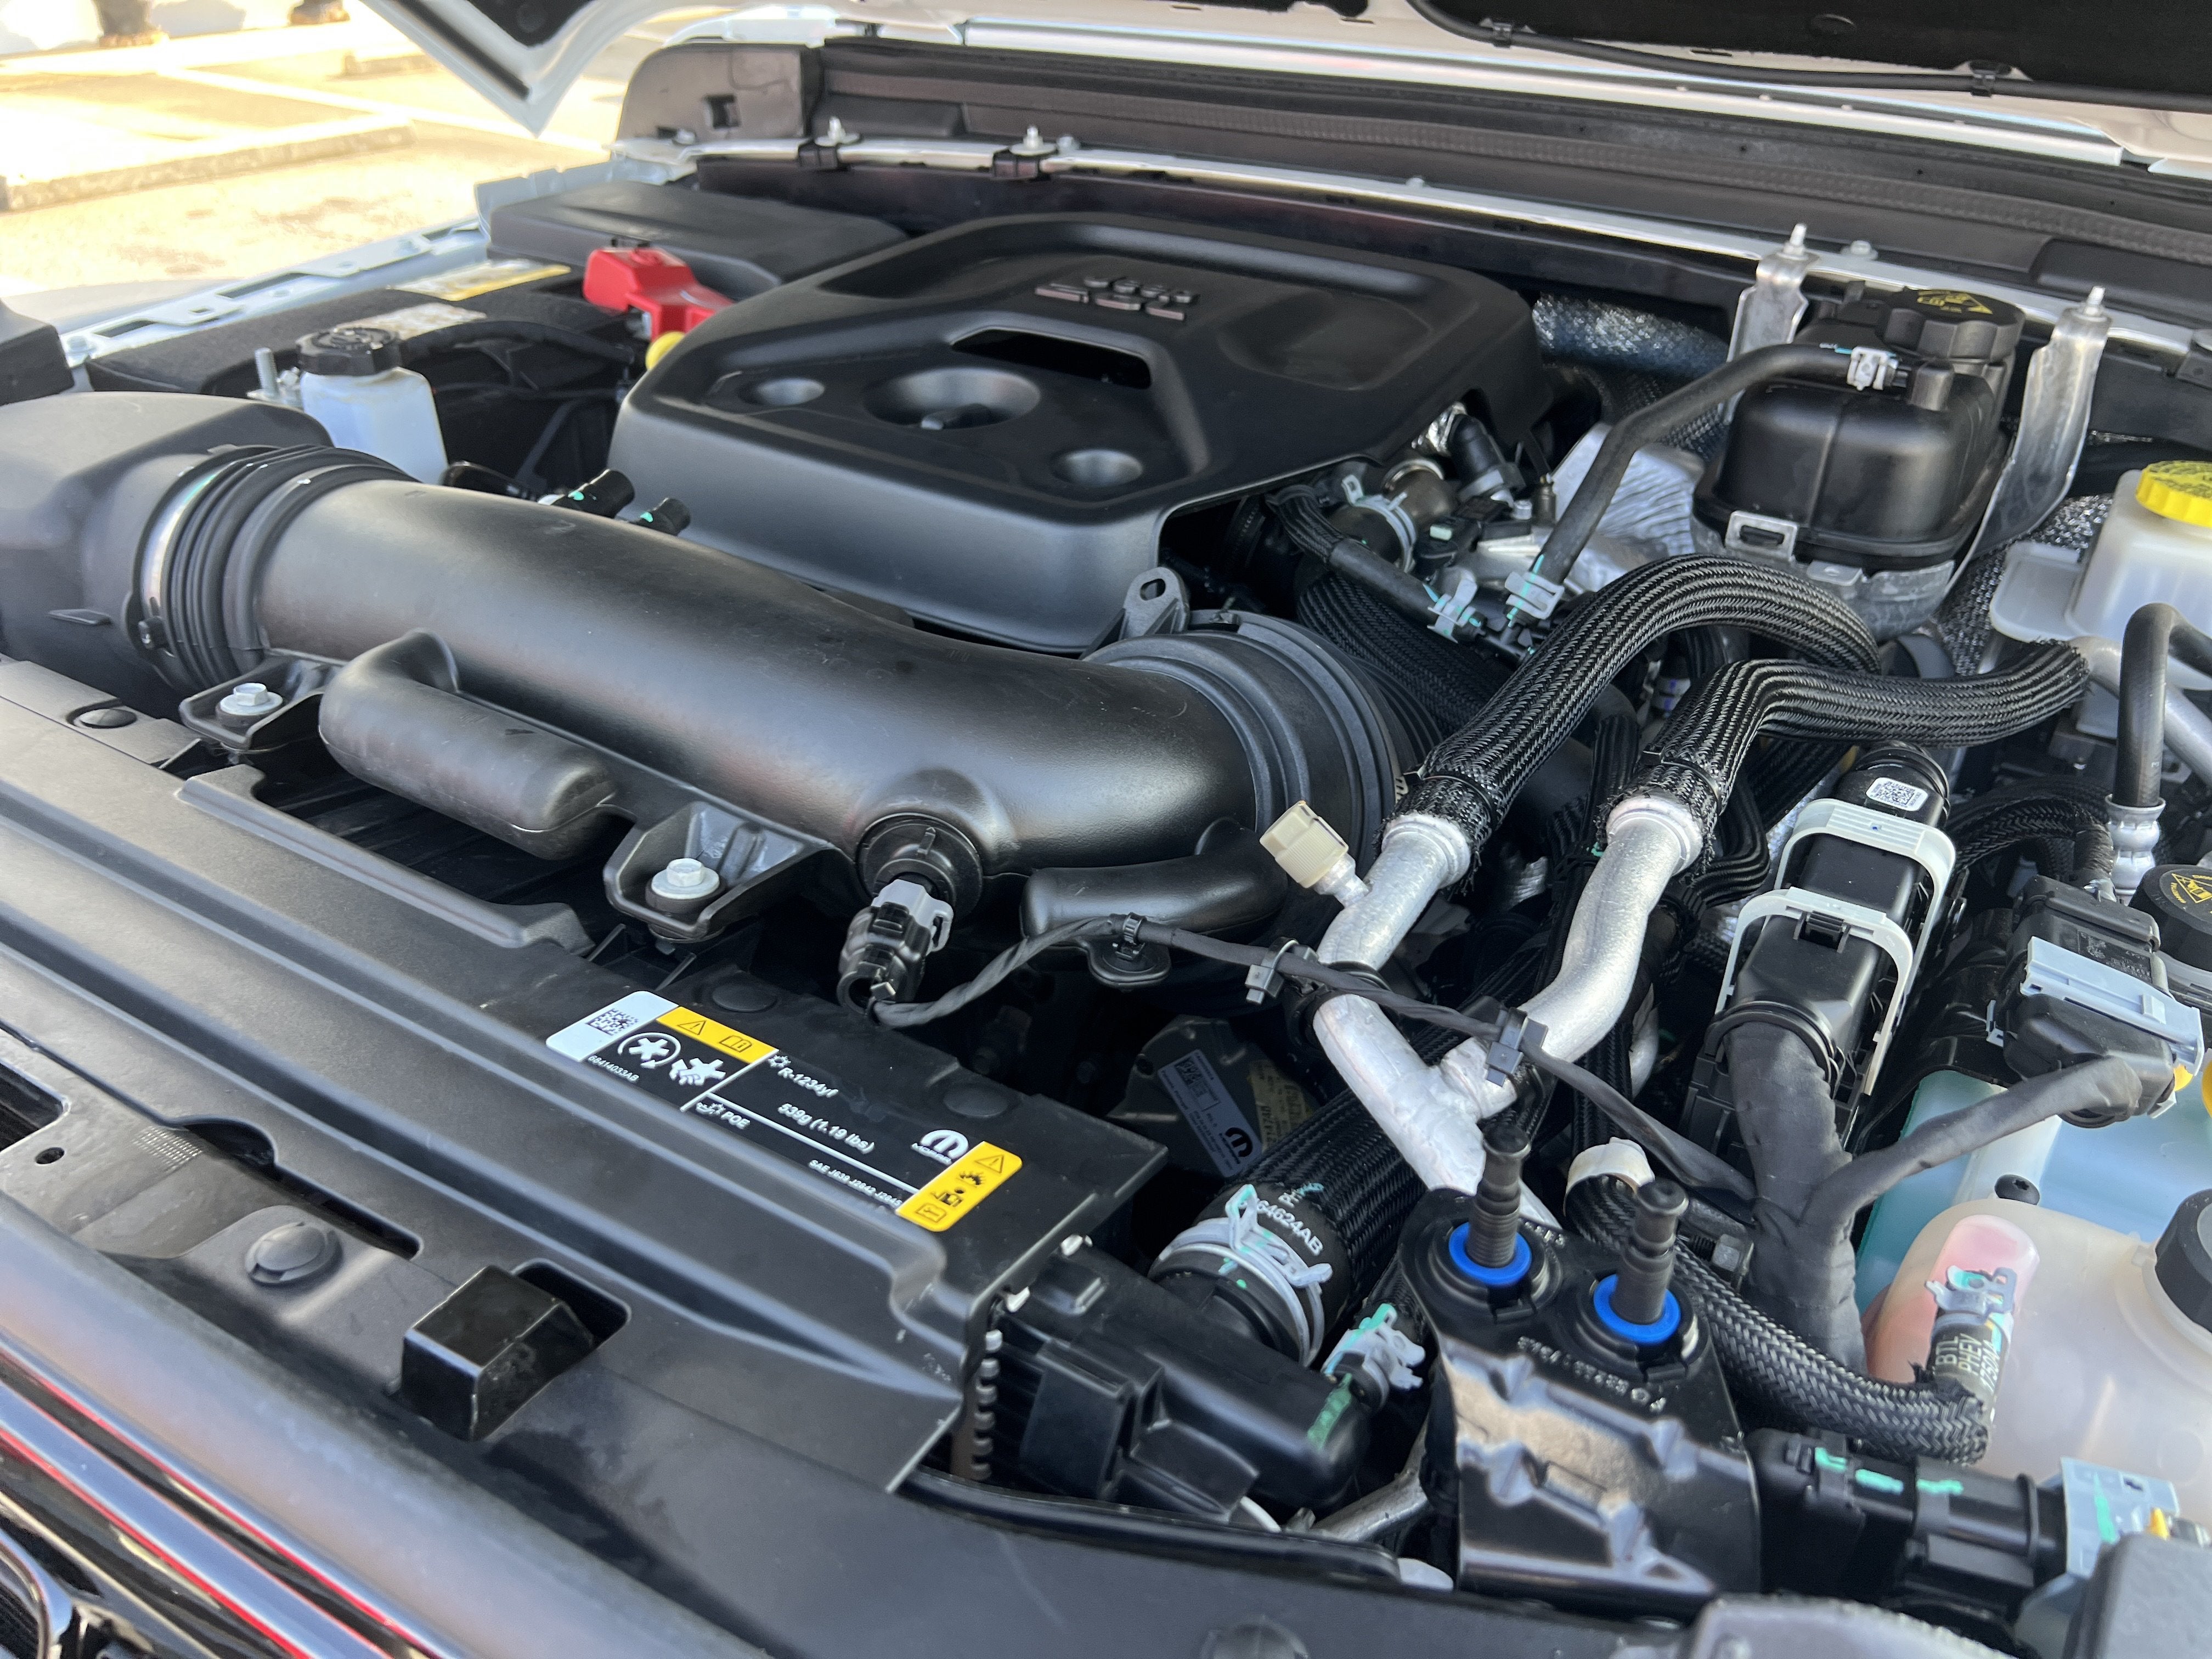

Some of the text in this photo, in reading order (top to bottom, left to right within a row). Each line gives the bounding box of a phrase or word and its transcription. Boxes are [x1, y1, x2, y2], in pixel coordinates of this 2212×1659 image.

[777, 1067, 839, 1098] R-1234yf
[721, 1112, 751, 1130] POE
[777, 1103, 875, 1154] 539g (1.19 lbs)
[808, 1159, 831, 1174] SAE
[1240, 1198, 1323, 1256] 64624AB
[1935, 1335, 1959, 1365] BTL
[1957, 1333, 1982, 1376] PHEV
